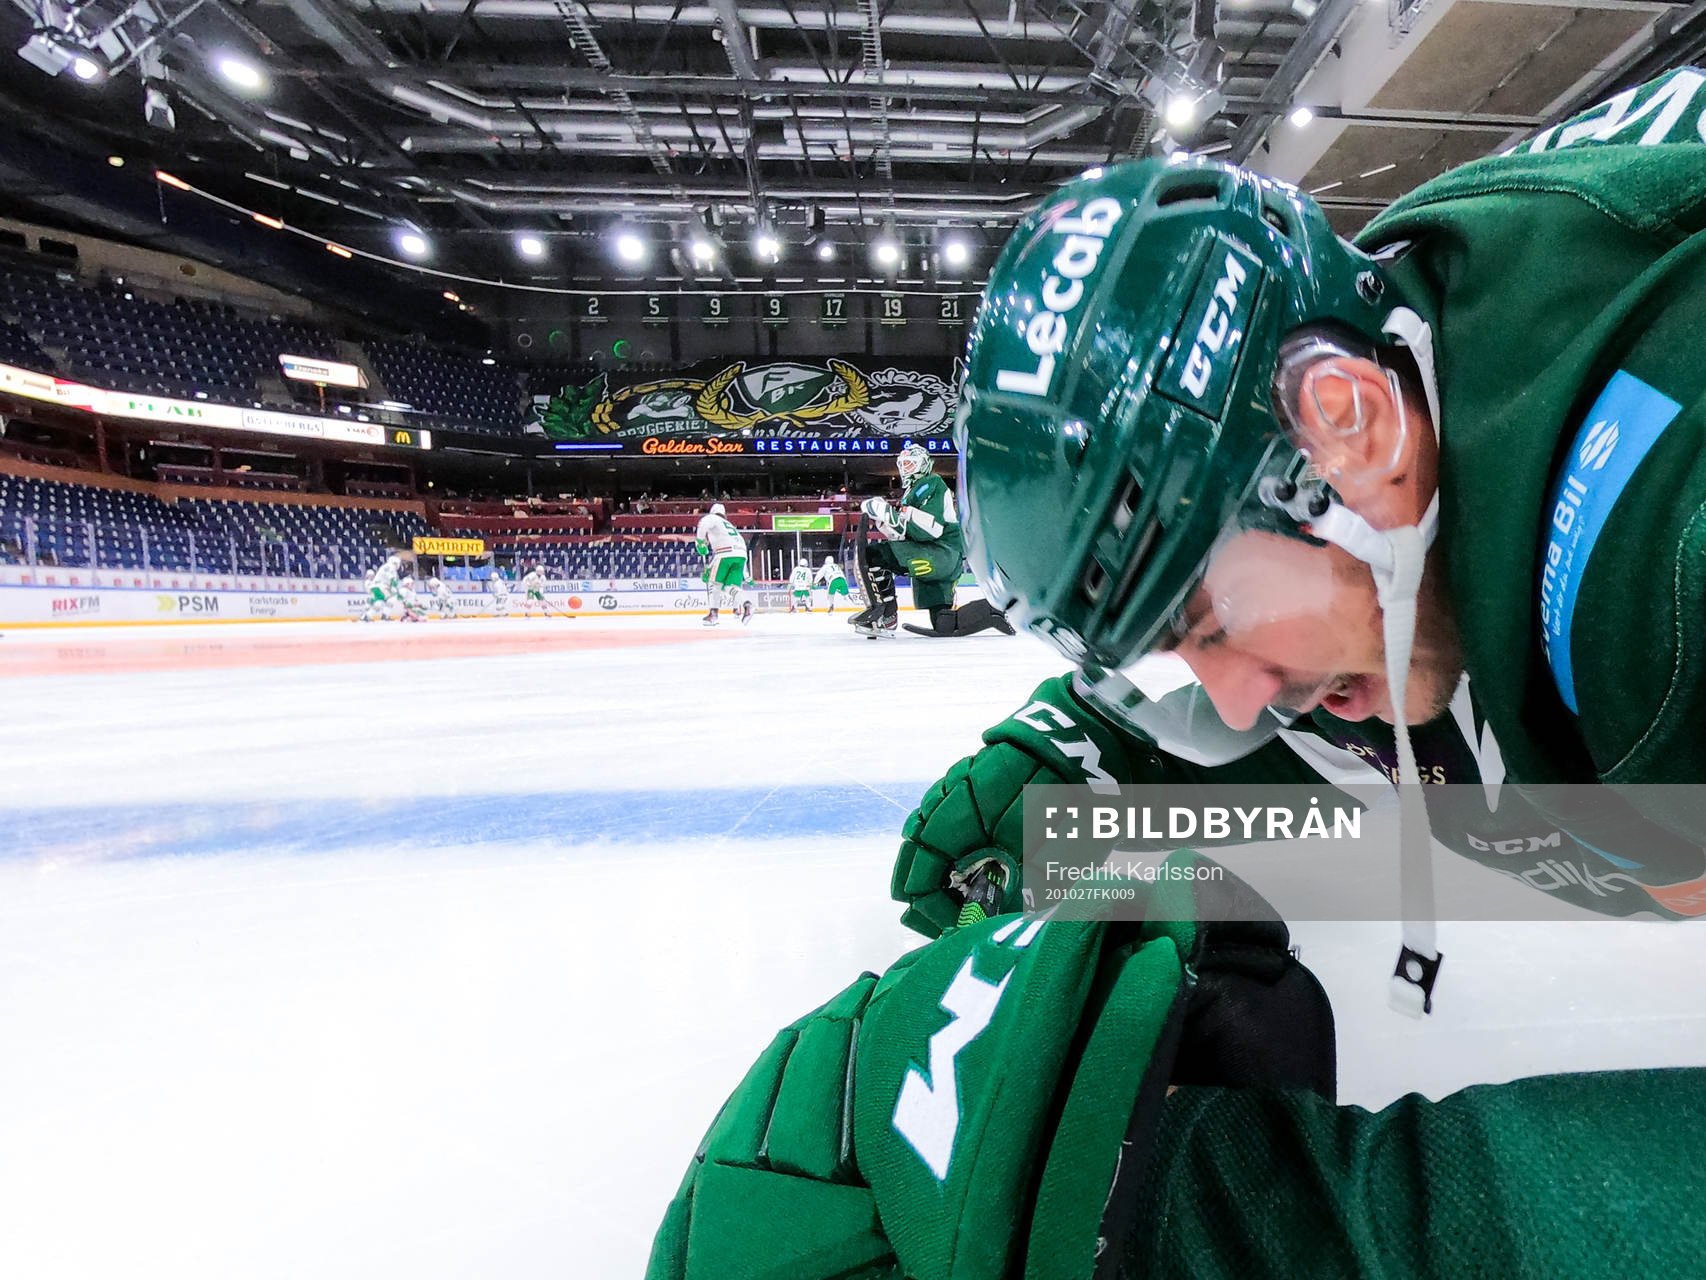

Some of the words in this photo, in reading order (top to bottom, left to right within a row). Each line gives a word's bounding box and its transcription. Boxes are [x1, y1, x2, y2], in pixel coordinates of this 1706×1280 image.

[588, 297, 599, 315] 2
[649, 297, 660, 315] 5
[996, 197, 1123, 397] Lecab
[710, 298, 721, 316] 9
[769, 298, 781, 316] 9
[826, 299, 842, 316] 17
[884, 299, 901, 317] 19
[941, 300, 959, 318] 21
[1180, 252, 1247, 399] CCM
[643, 438, 705, 454] Golden
[705, 439, 744, 453] Star
[757, 441, 888, 450] RESTAURANG
[1553, 475, 1589, 534] Bil
[723, 520, 738, 536] 5
[633, 581, 662, 591] Svema
[665, 580, 677, 590] Bil
[179, 595, 219, 612] PSM
[457, 599, 485, 608] TEGEL
[1466, 832, 1561, 855] CCM
